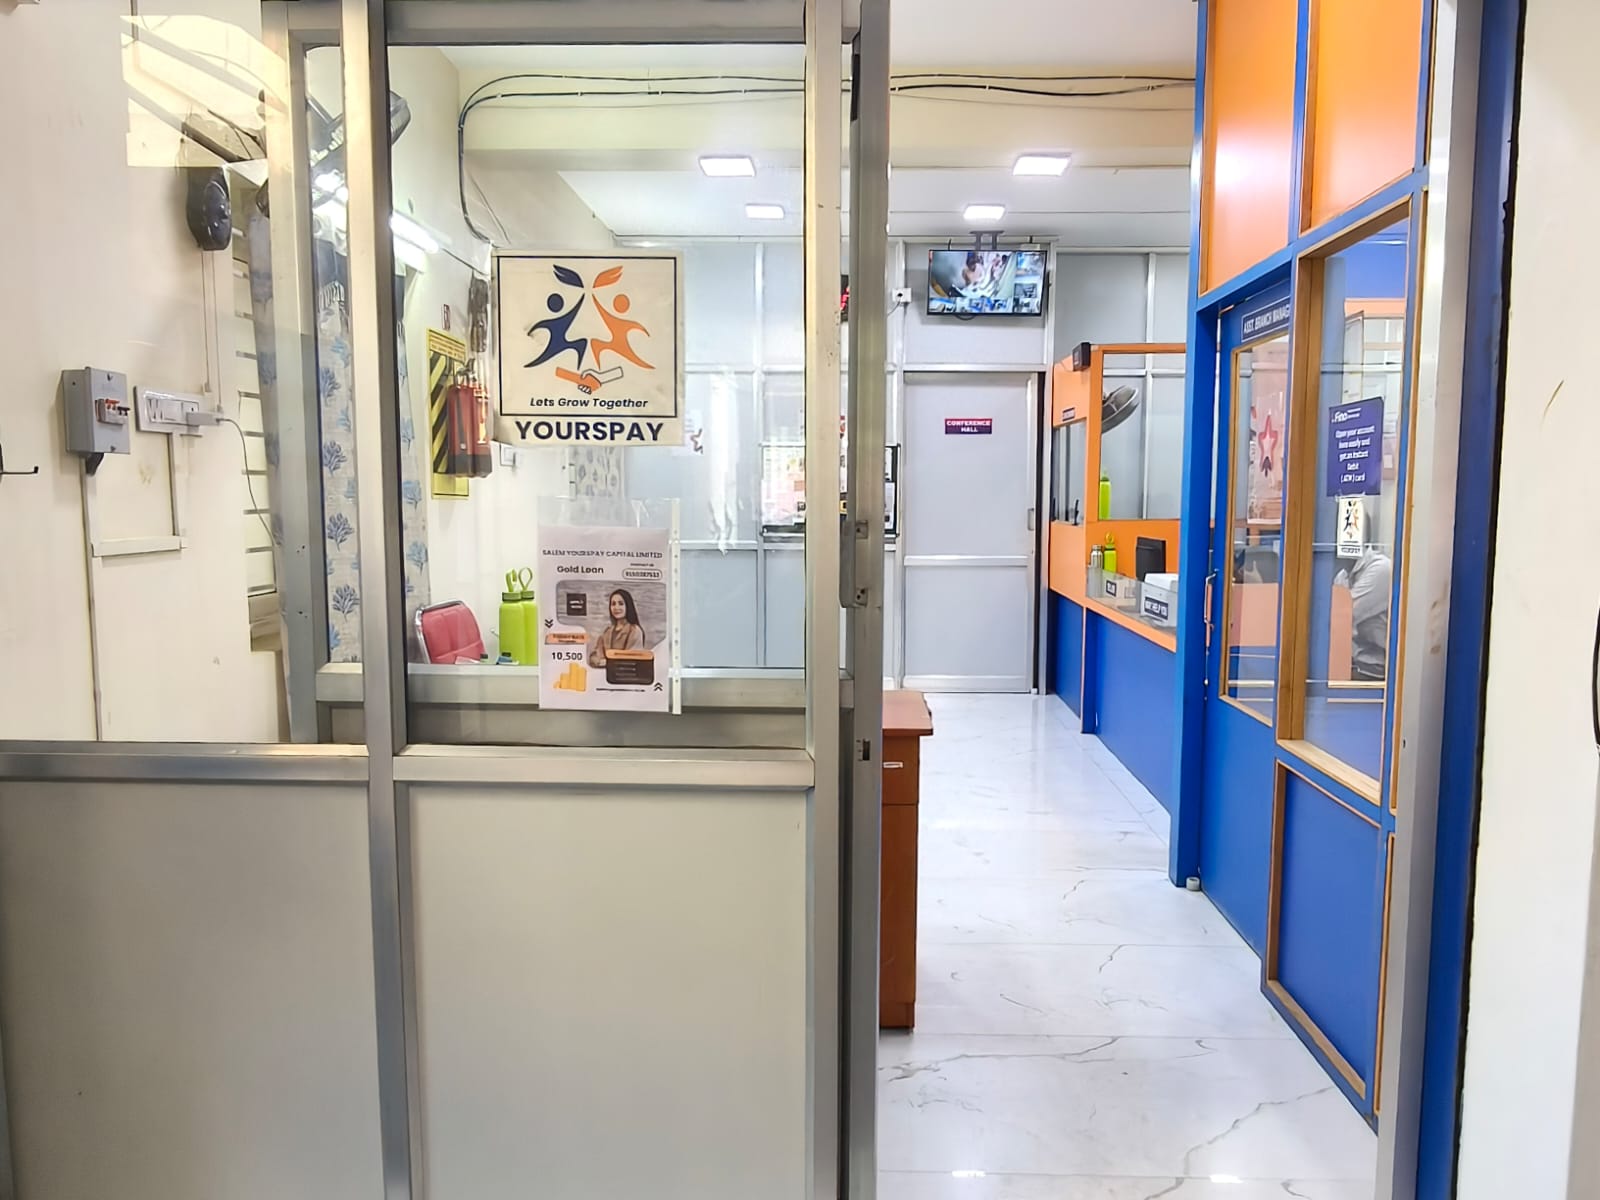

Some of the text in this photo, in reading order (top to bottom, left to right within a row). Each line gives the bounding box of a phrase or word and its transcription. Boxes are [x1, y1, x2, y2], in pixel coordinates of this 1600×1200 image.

[530, 398, 649, 410] Lets Grow Together
[515, 421, 664, 441] YOURSPAY
[557, 565, 604, 574] Gold Loan
[551, 652, 583, 661] 10,500
